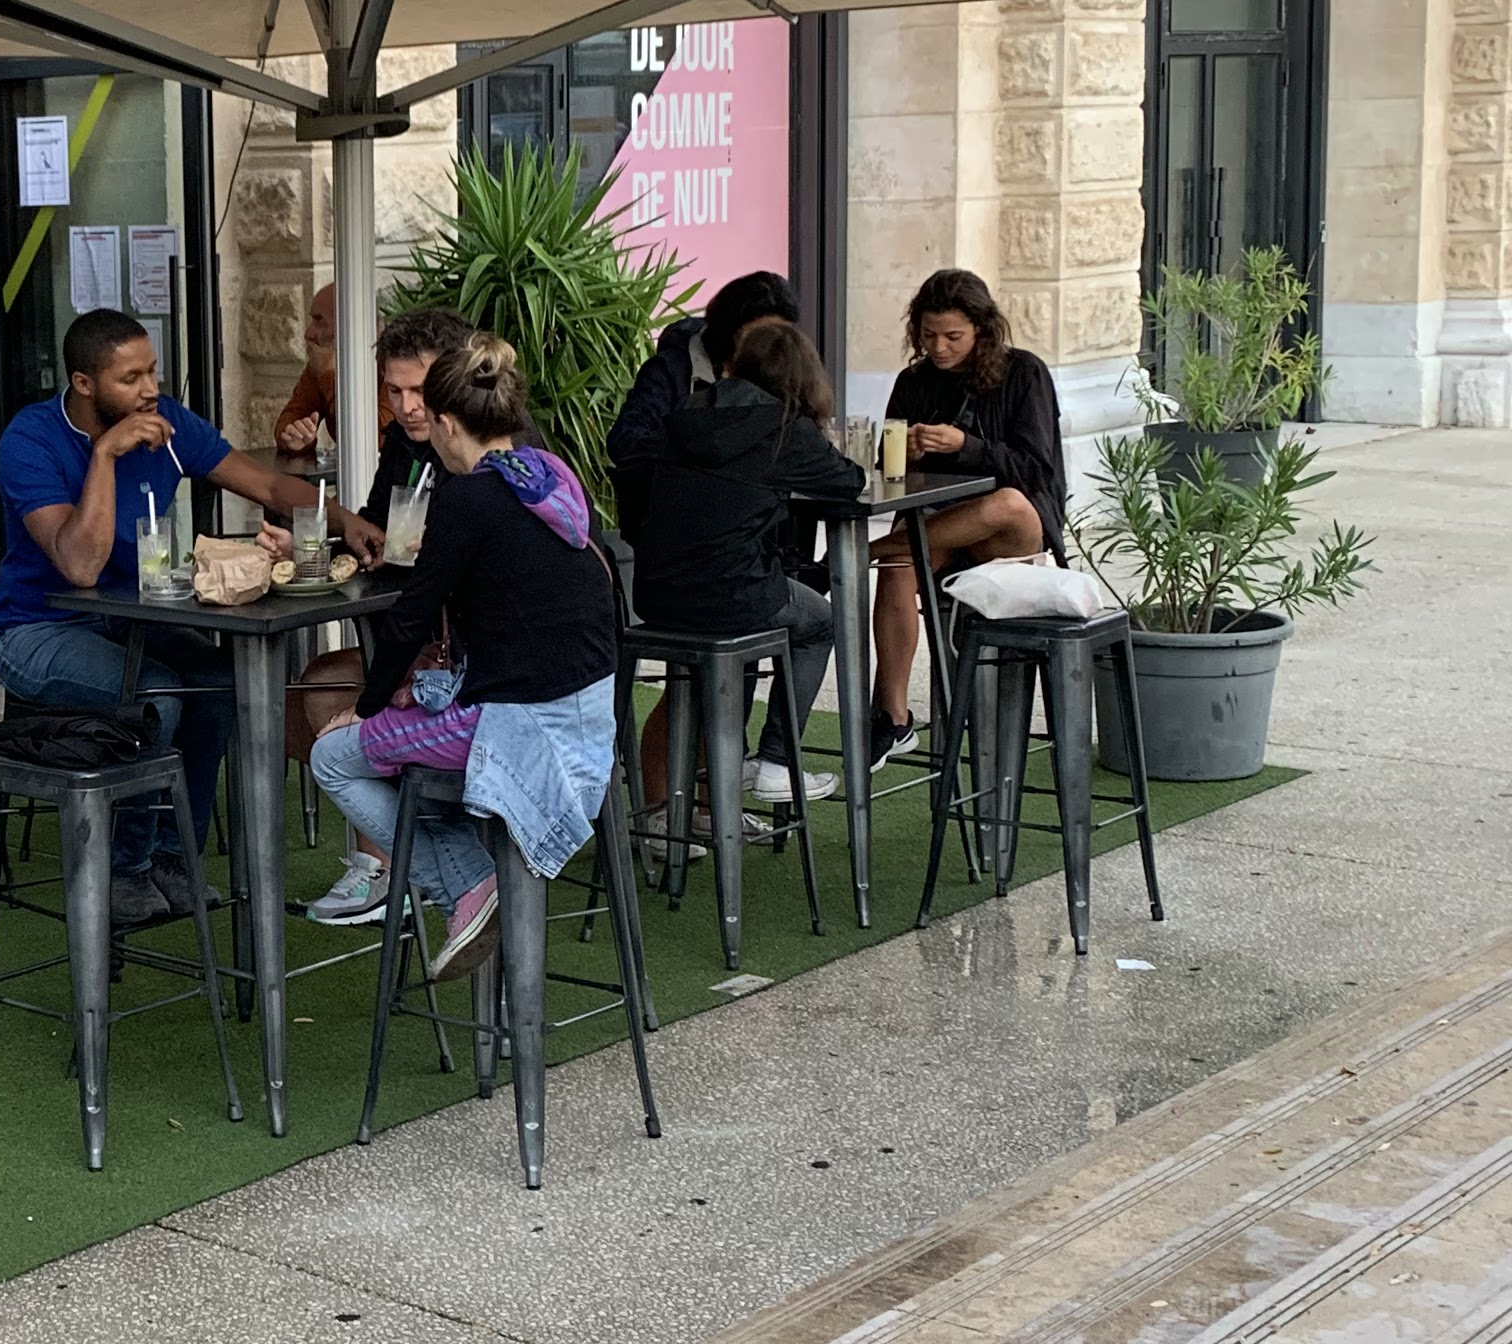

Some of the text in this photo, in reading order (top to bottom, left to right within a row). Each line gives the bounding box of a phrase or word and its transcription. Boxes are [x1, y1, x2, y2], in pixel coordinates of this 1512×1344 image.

[630, 22, 734, 72] DE JOUR
[631, 92, 733, 150] COMME
[632, 167, 732, 228] DE NUIT
